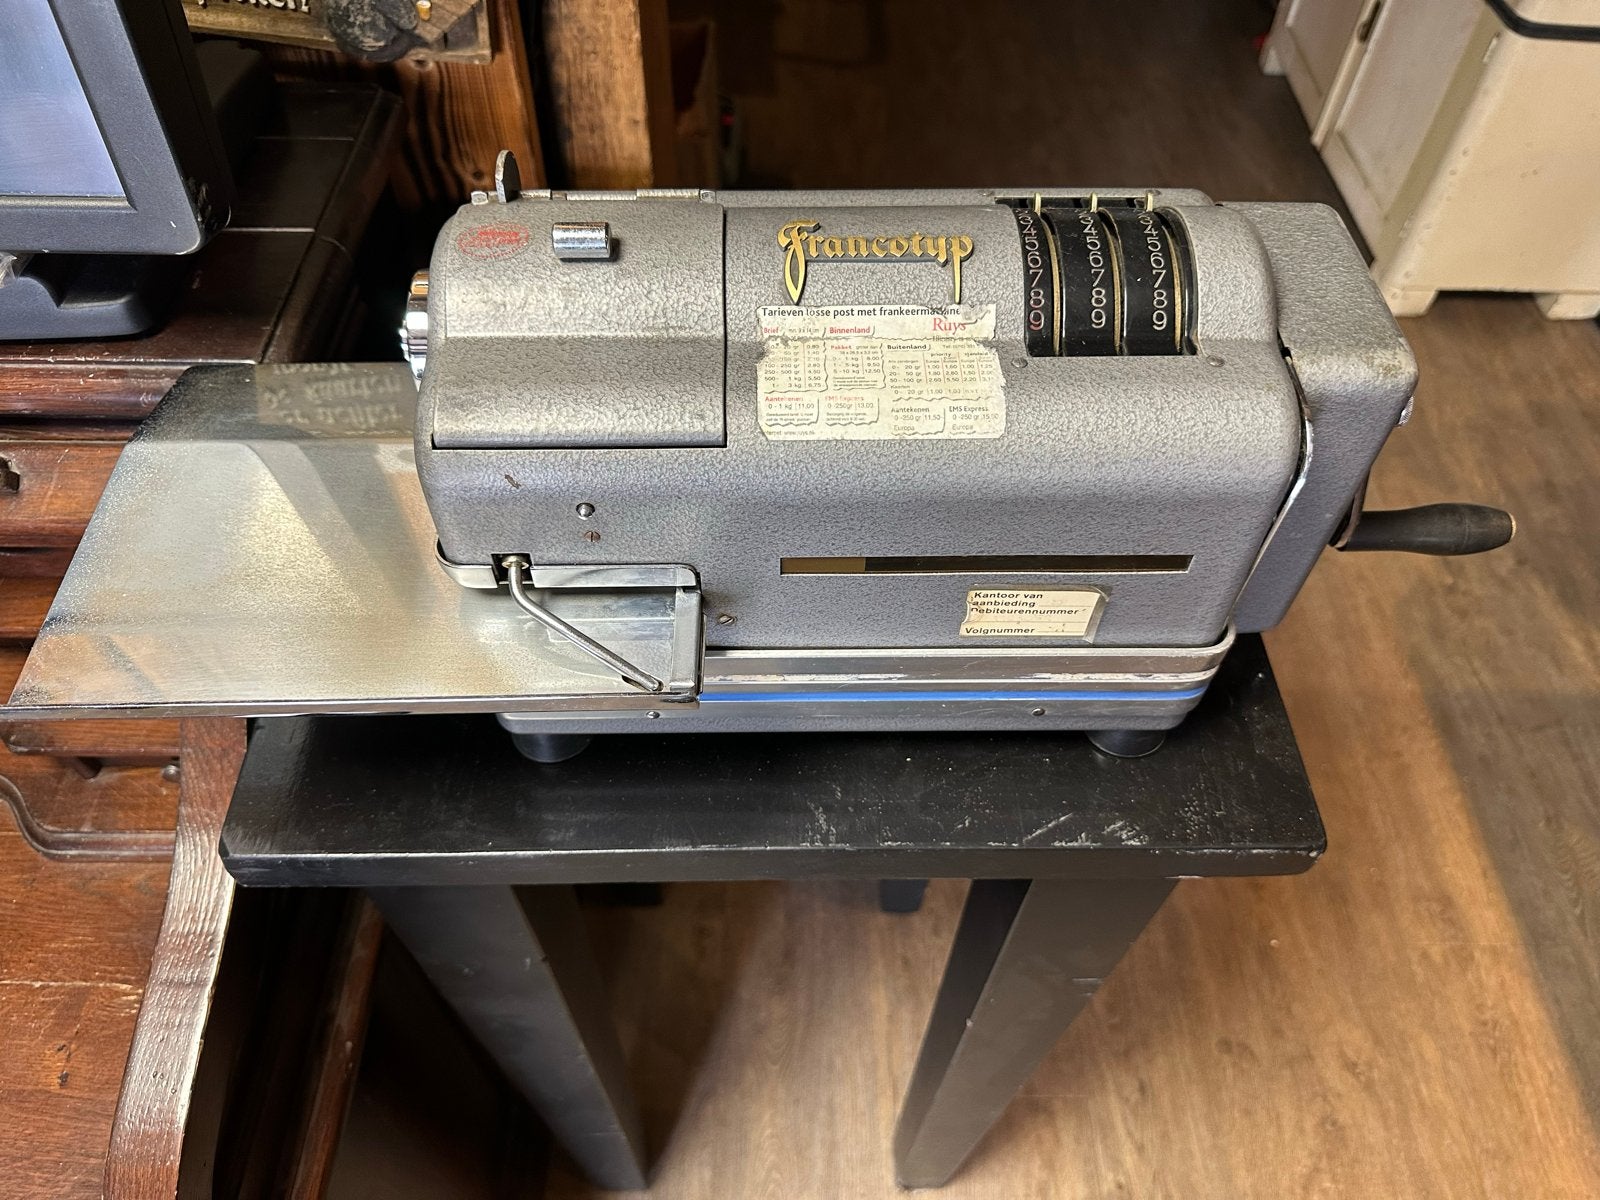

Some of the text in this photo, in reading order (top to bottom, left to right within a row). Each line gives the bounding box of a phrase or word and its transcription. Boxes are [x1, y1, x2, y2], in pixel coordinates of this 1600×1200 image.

[1022, 224, 1037, 236] 4
[1083, 224, 1097, 236] 4
[1144, 225, 1158, 236] 4
[1025, 236, 1039, 250] 5
[1086, 236, 1100, 250] 5
[1147, 237, 1161, 251] 5
[777, 218, 974, 304] Francotyp
[1027, 251, 1041, 268] 6
[1089, 251, 1103, 268] 6
[1151, 252, 1164, 269] 6
[1029, 269, 1043, 287] 7
[1091, 269, 1105, 287] 7
[1152, 270, 1166, 288] 7
[1030, 288, 1045, 308] 8
[1091, 288, 1106, 307] 8
[1153, 290, 1167, 309] 8
[762, 307, 961, 319] Tarieven losse post met frankeermaine
[1029, 310, 1045, 330] 9
[1091, 308, 1106, 328] 9
[1152, 310, 1167, 330] 9
[830, 326, 871, 334] Binnenland
[932, 318, 966, 335] Ruys
[970, 607, 1080, 615] Debiteurennummer
[972, 600, 1036, 608] aanbieding
[964, 627, 1036, 635] Volgnummer
